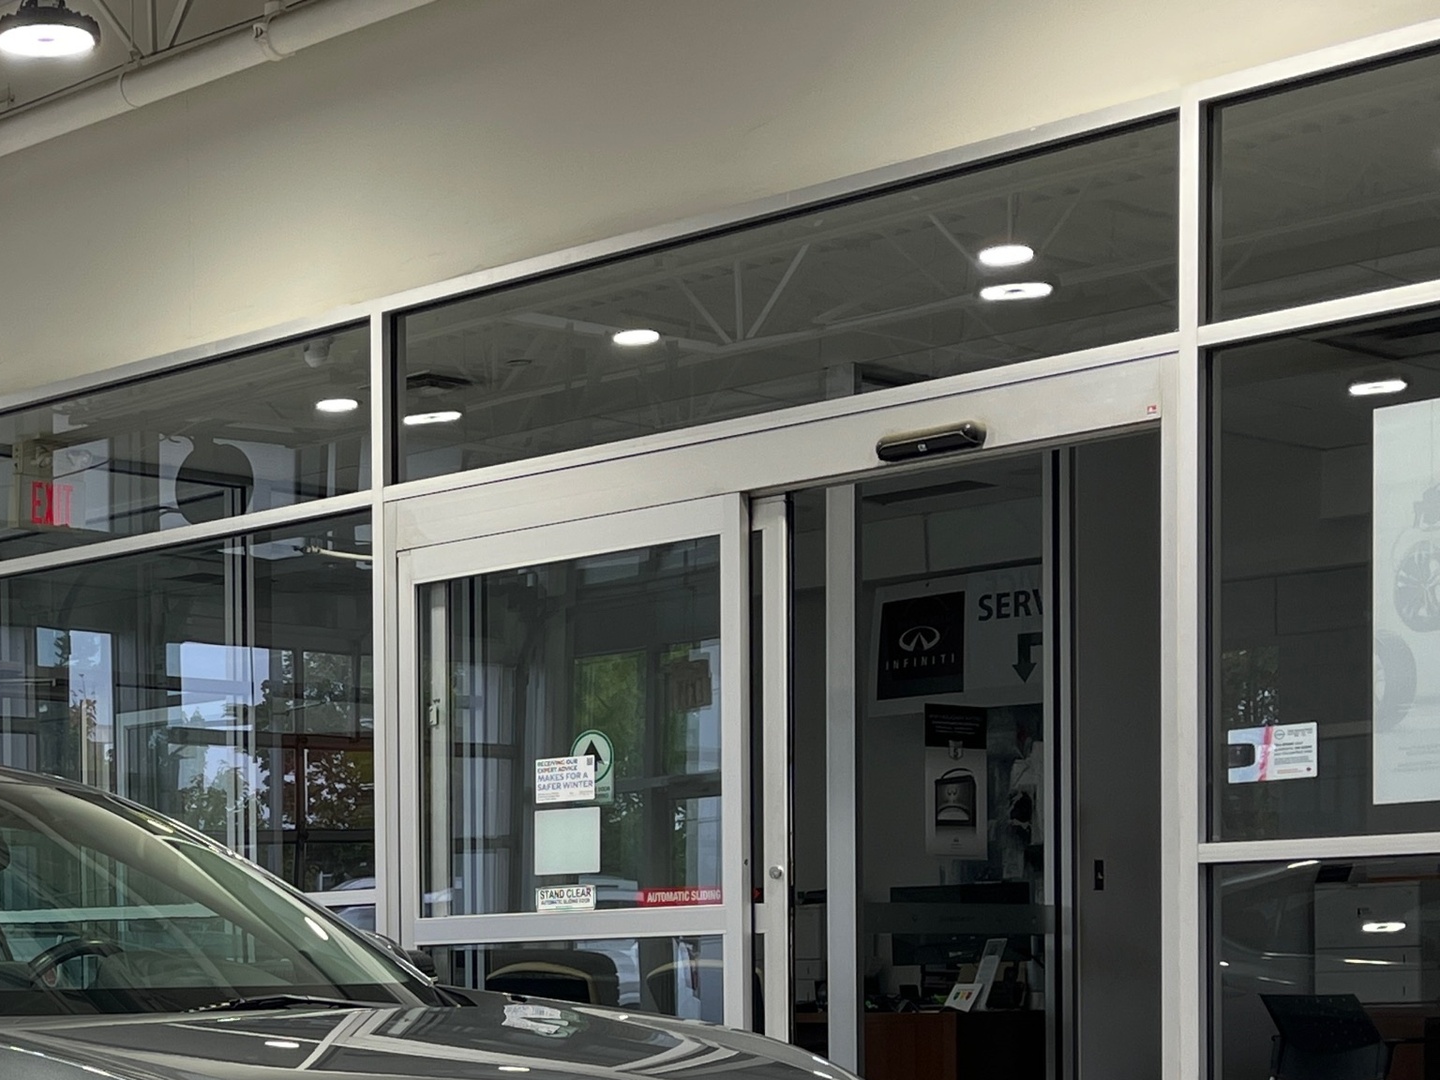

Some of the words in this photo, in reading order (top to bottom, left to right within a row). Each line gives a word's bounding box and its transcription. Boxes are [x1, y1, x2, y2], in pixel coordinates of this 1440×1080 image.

[32, 481, 73, 527] EXIT
[886, 652, 955, 671] INFINITI
[538, 773, 564, 782] MAKES
[565, 772, 581, 780] FOR
[582, 771, 589, 779] A
[537, 782, 561, 792] SAFER
[563, 780, 593, 789] WINTER
[540, 889, 565, 900] STAND
[566, 887, 592, 898] CLEAR
[647, 891, 690, 903] AUTOMATIC
[691, 889, 721, 901] SLIDING
